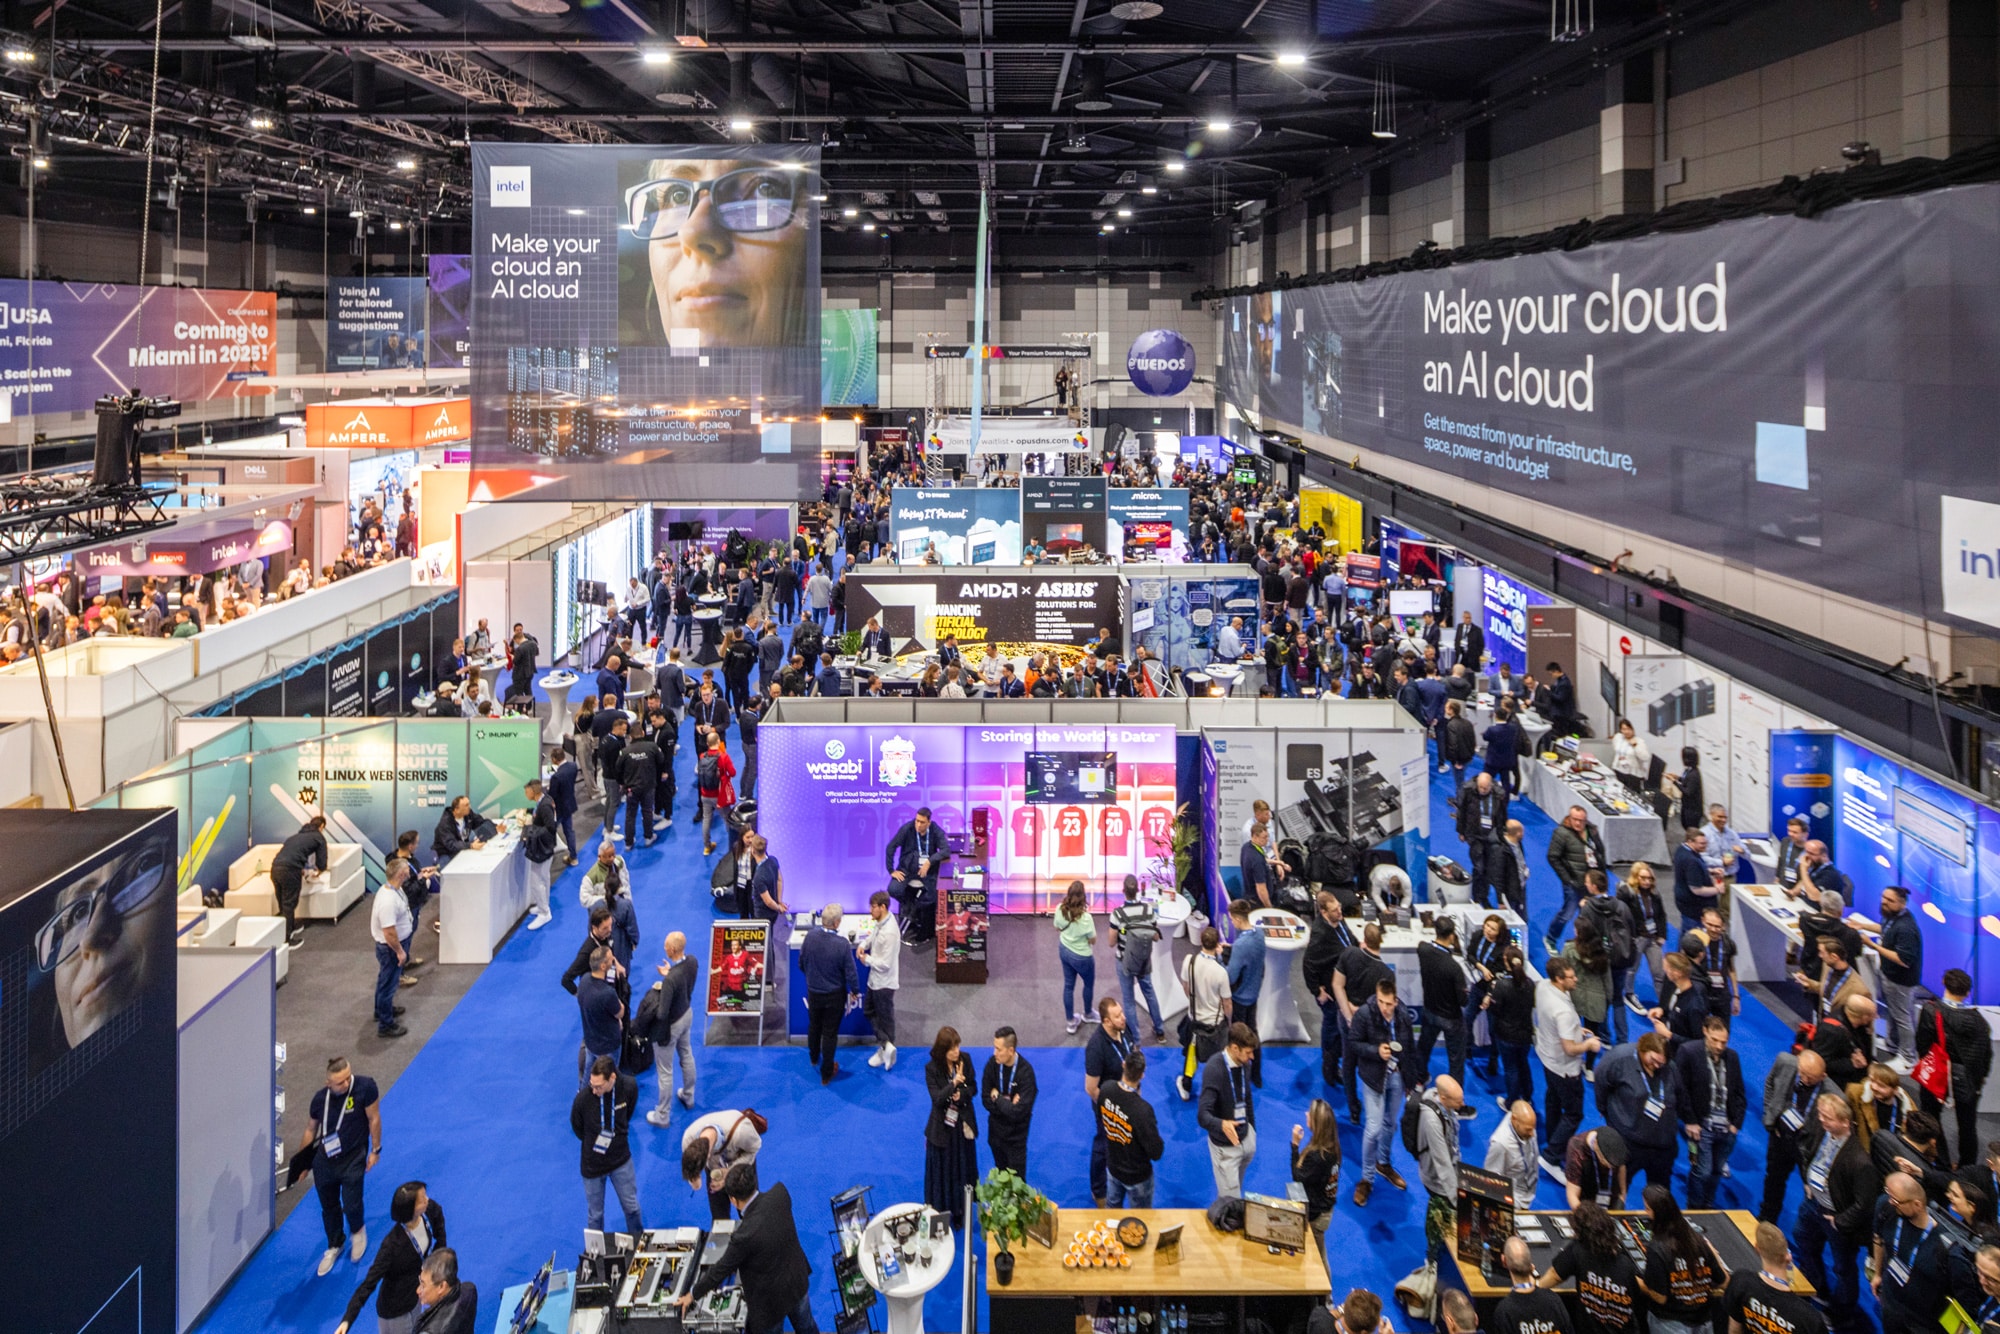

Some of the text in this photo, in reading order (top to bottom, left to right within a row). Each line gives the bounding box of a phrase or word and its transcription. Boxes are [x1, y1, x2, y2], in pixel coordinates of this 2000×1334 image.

[496, 180, 524, 192] intel
[491, 234, 600, 259] Make your
[491, 258, 582, 276] cloud an
[339, 287, 380, 298] Using AI
[491, 280, 579, 299] AI cloud
[338, 298, 393, 308] for tailored
[1423, 262, 1728, 346] Make your cloud
[10, 308, 52, 324] USA
[338, 310, 404, 320] domain name
[174, 320, 268, 344] Coming to
[338, 321, 399, 332] suggestions
[15, 336, 52, 347] Florida
[128, 344, 268, 367] Miami in 2025!
[1137, 358, 1186, 371] WEDOS
[4, 366, 72, 380] Scale in the
[1423, 352, 1594, 412] an AI cloud
[650, 407, 666, 417] the
[720, 409, 742, 420] your
[629, 420, 732, 433] infrastructure, space,
[629, 432, 720, 444] power and budget
[947, 437, 964, 446] Join
[981, 437, 1009, 446] waitlist
[1016, 436, 1070, 446] opusdns.com
[1424, 412, 1638, 476] Get the most from your infrastructure,
[1424, 435, 1550, 480] space, power and budget
[244, 466, 267, 474] DELL
[898, 508, 924, 520] Making
[924, 508, 938, 520] IT
[153, 554, 184, 563] Lenovo
[1960, 539, 2000, 580] in
[959, 582, 1095, 598] AMD ASBIS
[924, 604, 982, 616] ADVANCING
[924, 616, 976, 628] ARTIFICIAL
[981, 730, 1034, 745] Storing
[1036, 730, 1061, 742] the
[1063, 730, 1118, 742] World's
[298, 743, 448, 754] COMPNSIVE
[397, 756, 448, 768] SUITE
[806, 758, 863, 774] wasabi
[298, 770, 448, 781] FOR LINUX WEB SERVERS
[1306, 768, 1321, 778] ES
[1024, 818, 1032, 836] 4
[1062, 818, 1081, 837] 23
[1106, 818, 1123, 837] 20
[1148, 818, 1166, 837] 17
[948, 894, 986, 903] LEGEND
[724, 930, 765, 941] LEGEND
[1587, 1270, 1628, 1296] fit for
[1750, 1297, 1796, 1332] fit for
[1534, 1318, 1555, 1334] for
